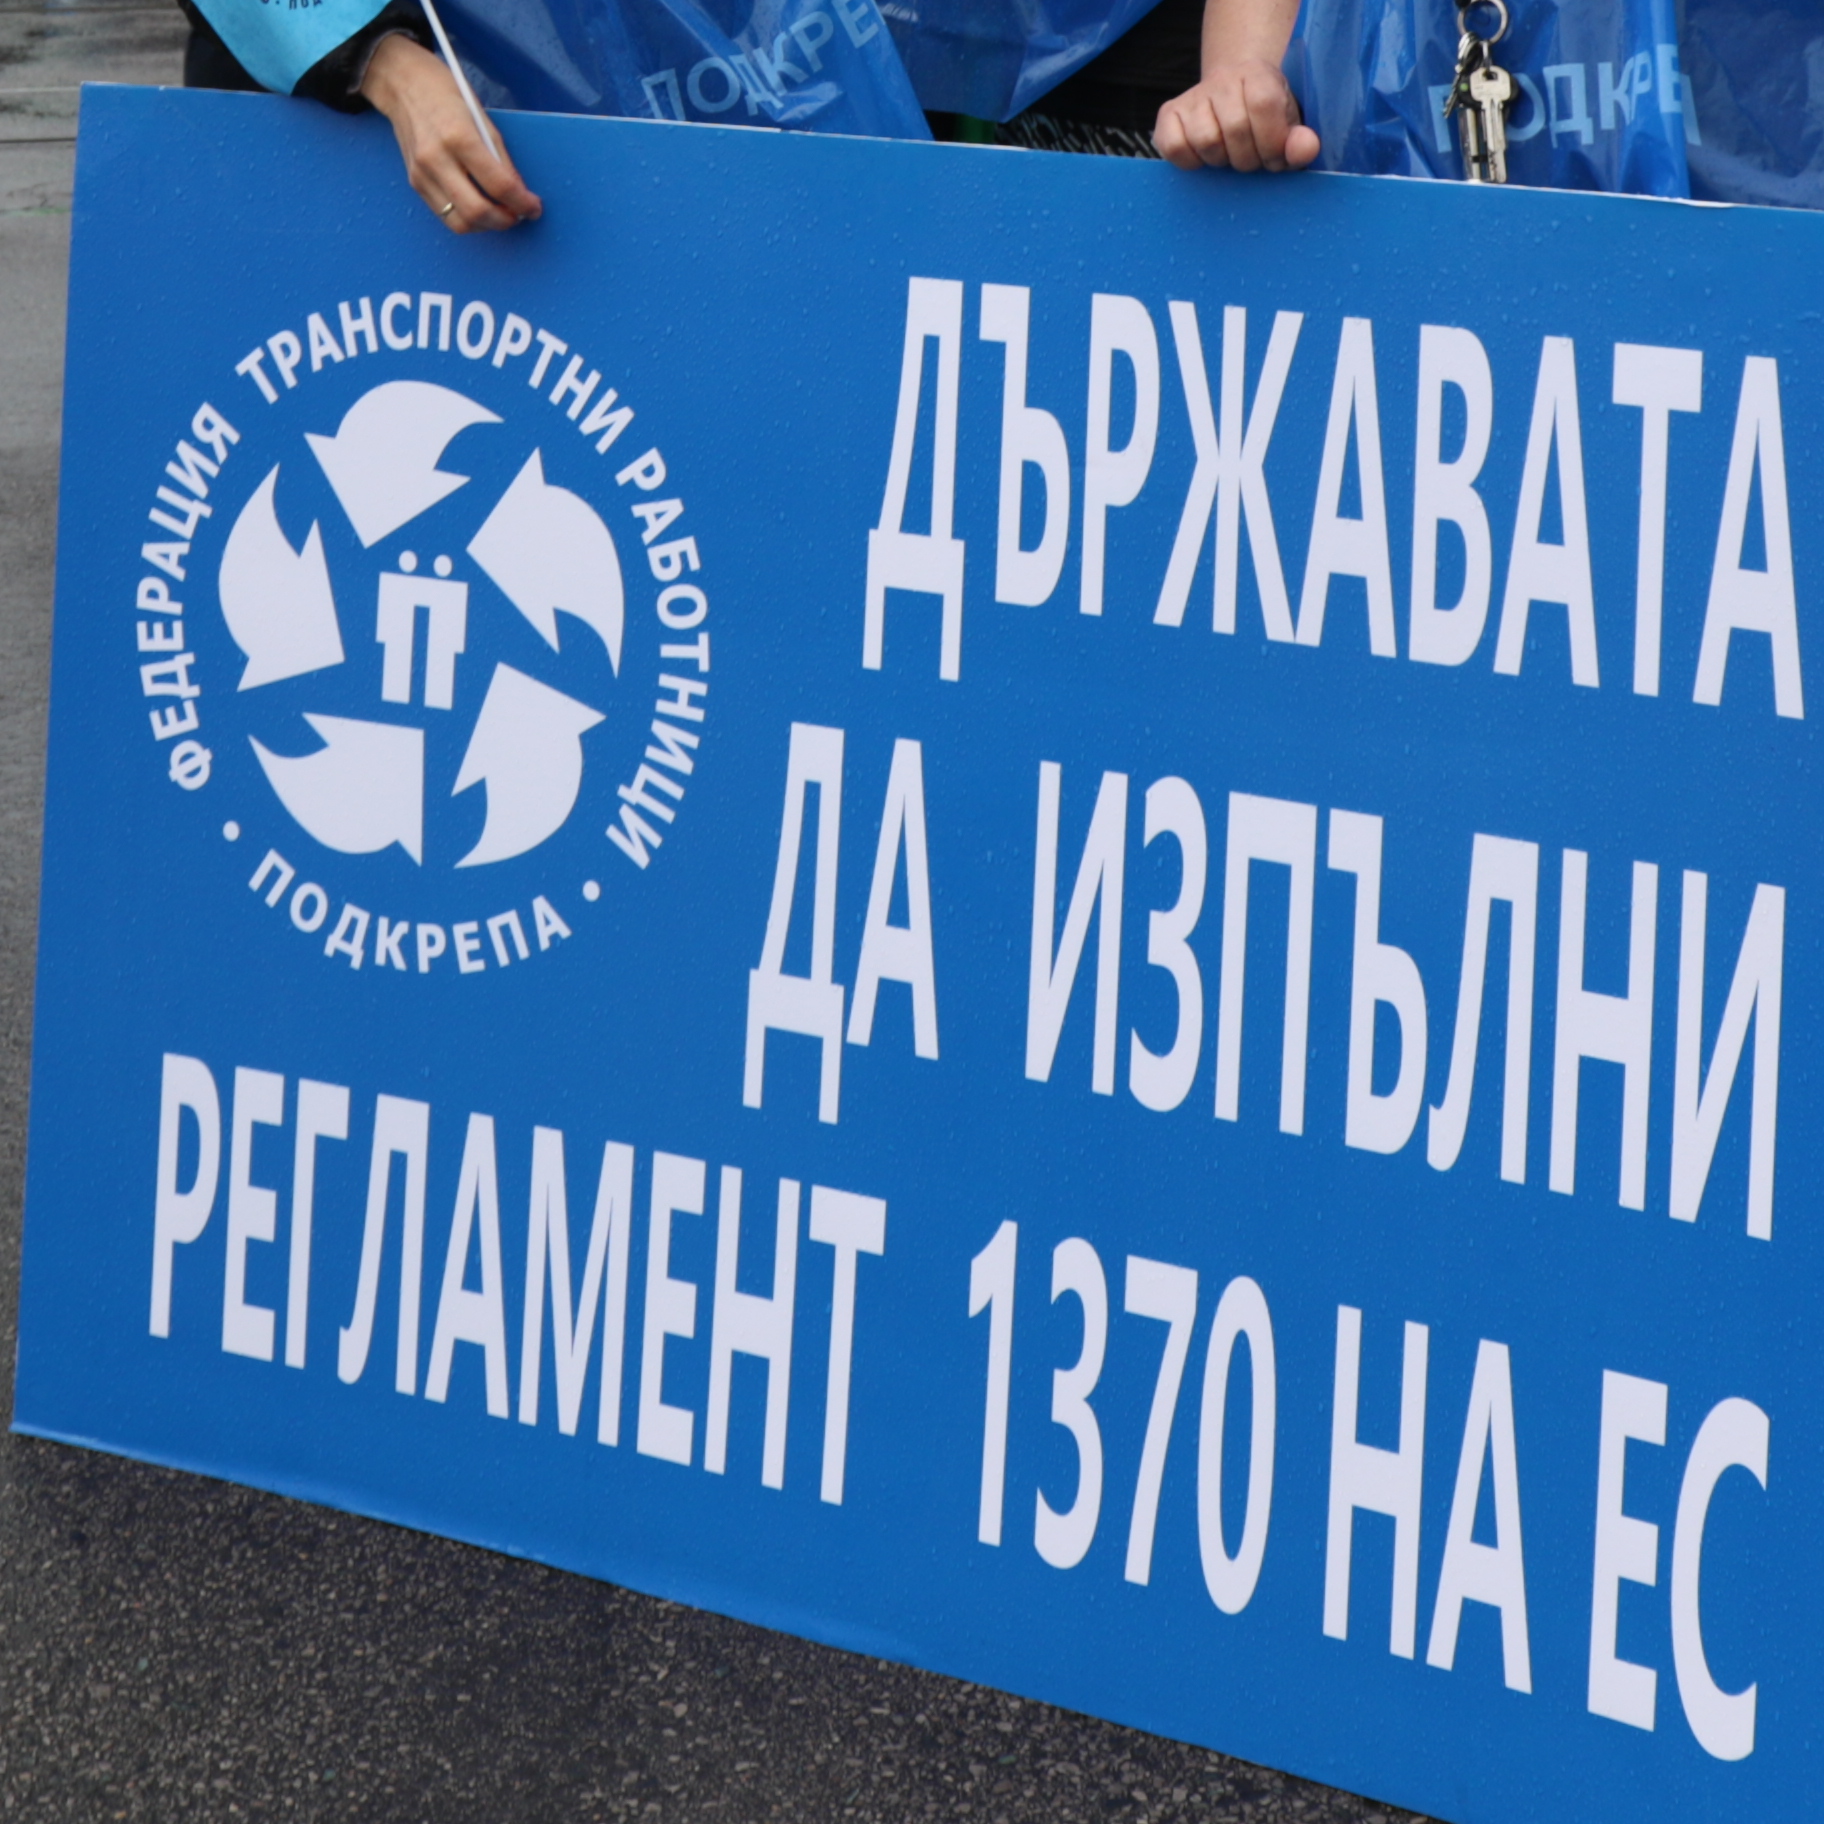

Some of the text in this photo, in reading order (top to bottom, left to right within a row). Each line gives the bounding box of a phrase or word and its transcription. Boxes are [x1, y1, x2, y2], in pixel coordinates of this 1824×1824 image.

[136, 291, 710, 870] ФЕДЕРАЦИЯ ТРАНСПОРТНИ РАБОТНИЦИ
[862, 275, 1804, 720] ДЪРЖАВАТА
[248, 848, 573, 974] ПОДКРЕПА
[742, 721, 1786, 1241] ДА ИЗПЪЛНИ
[148, 1052, 1770, 1762] РЕГЛАМЕНТ 1370 НА ЕС
